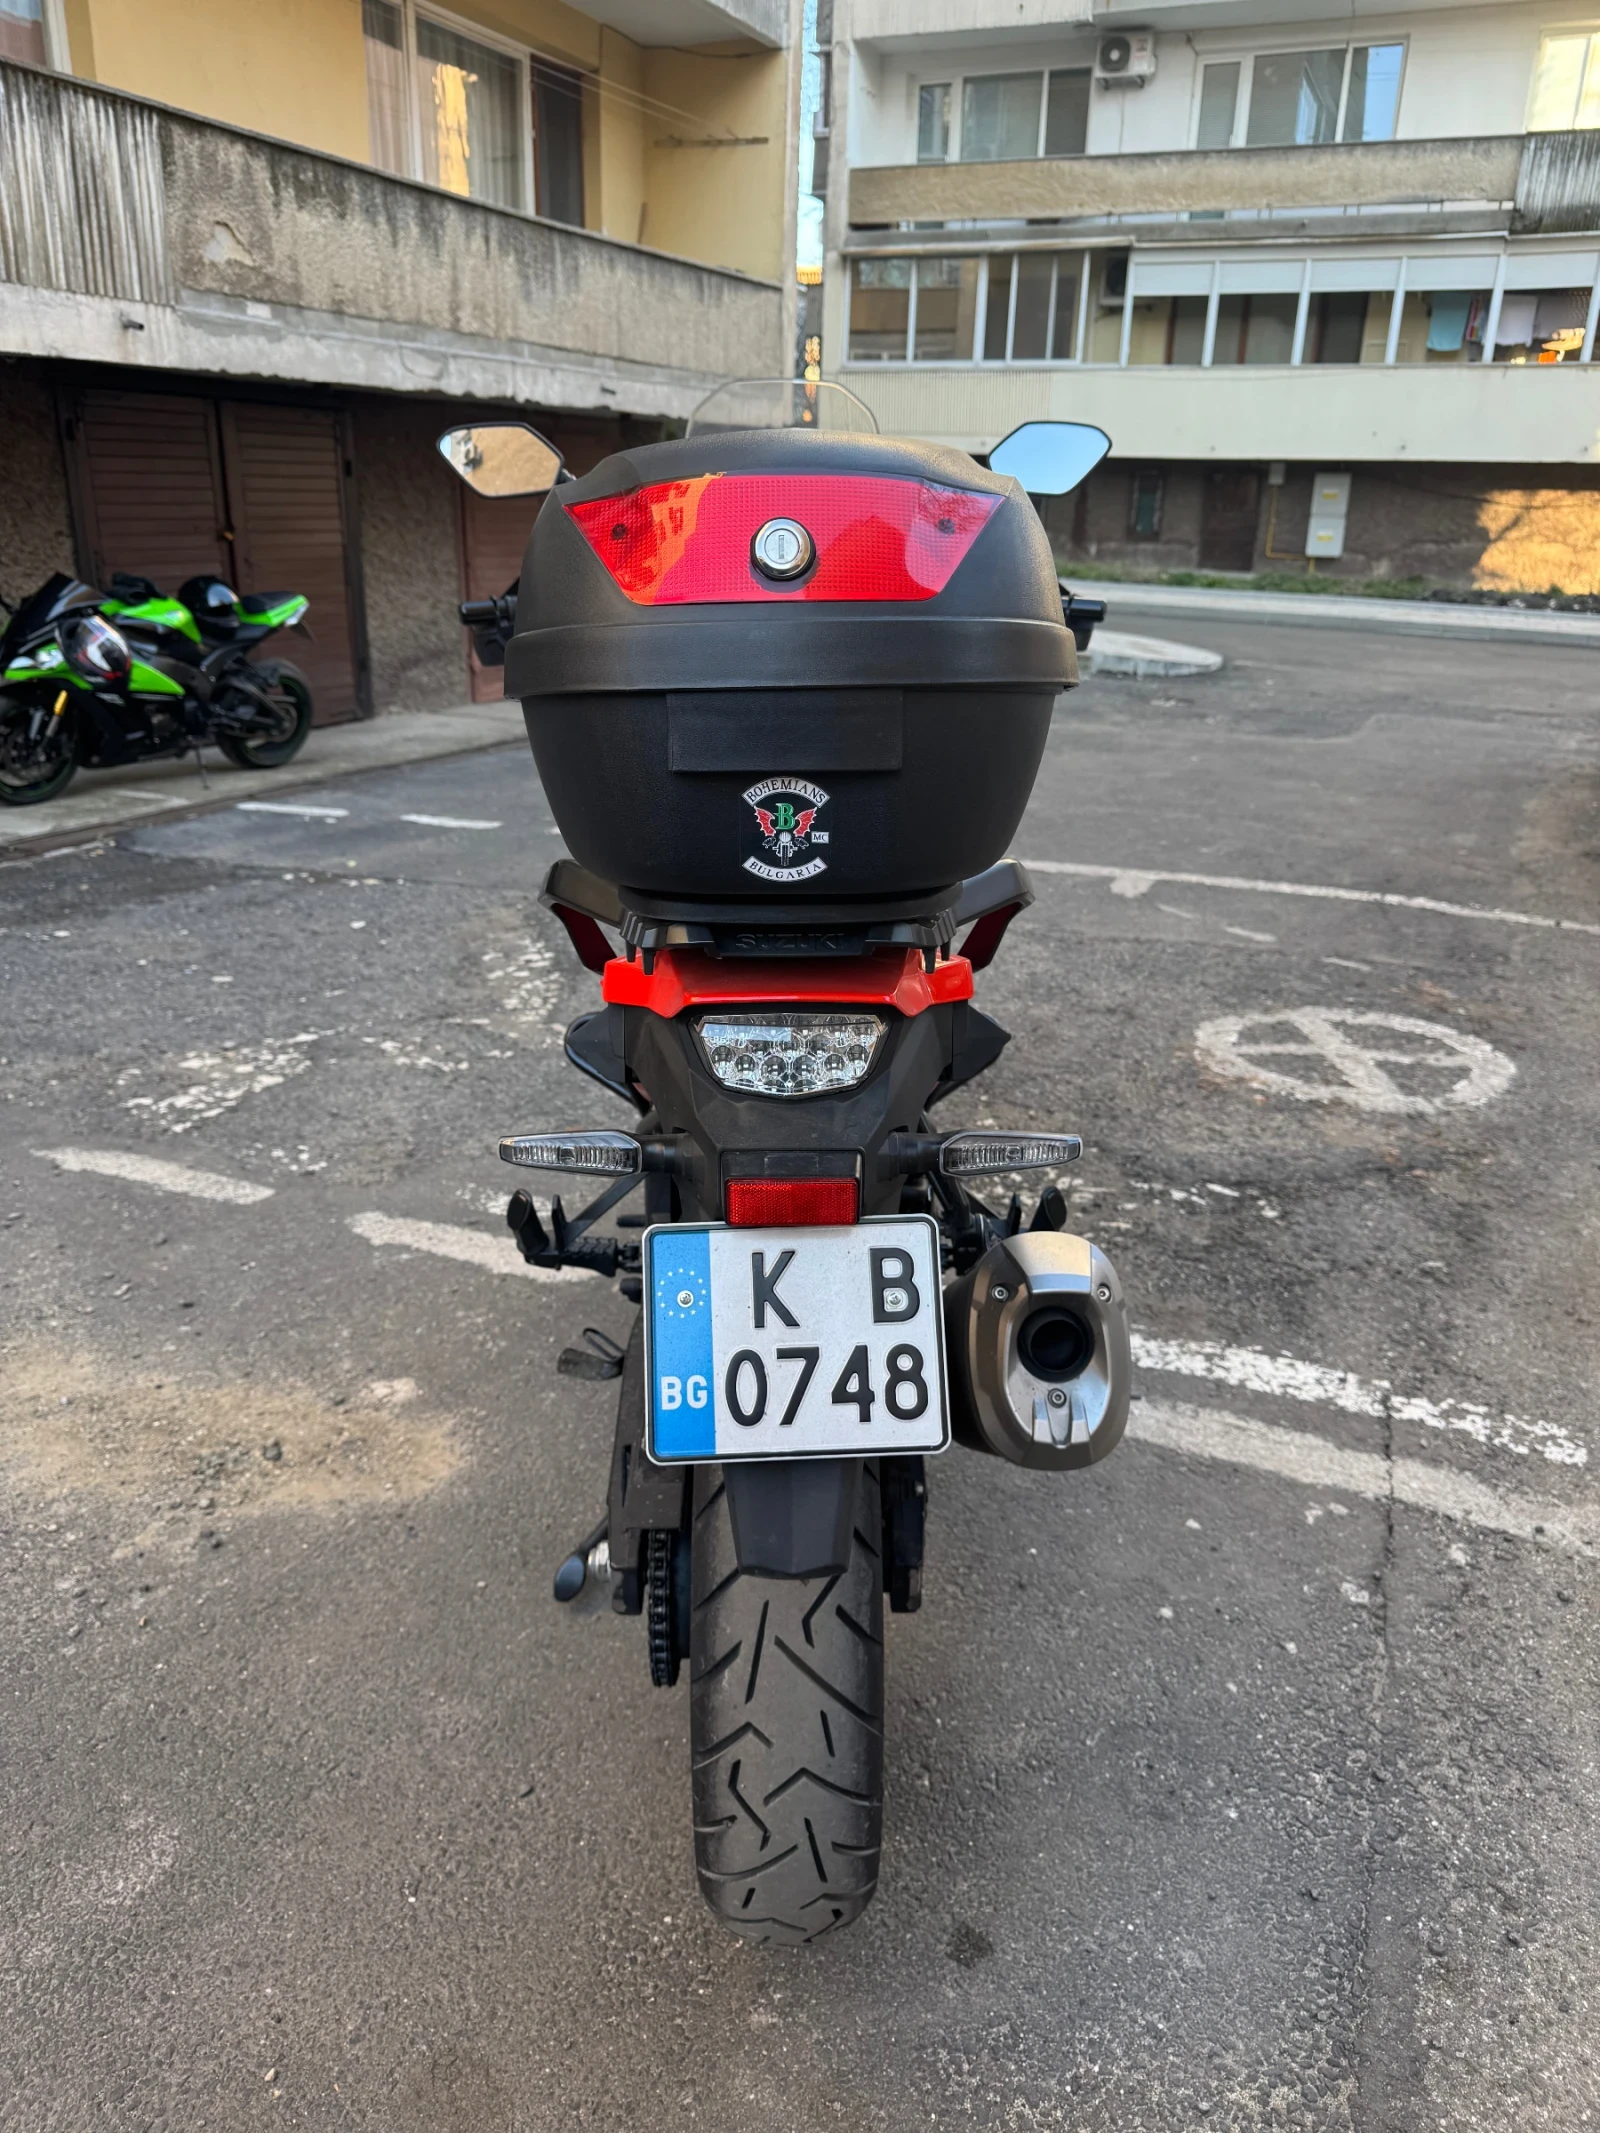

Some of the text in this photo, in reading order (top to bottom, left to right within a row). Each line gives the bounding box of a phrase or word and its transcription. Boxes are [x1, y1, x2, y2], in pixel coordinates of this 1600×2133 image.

[746, 778, 826, 804] BOHEMIANS
[773, 802, 796, 830] B
[813, 833, 828, 842] MC
[749, 861, 822, 880] BULGARIA
[751, 1247, 921, 1329] K B
[660, 1374, 708, 1411] BG
[724, 1343, 929, 1428] 0748
